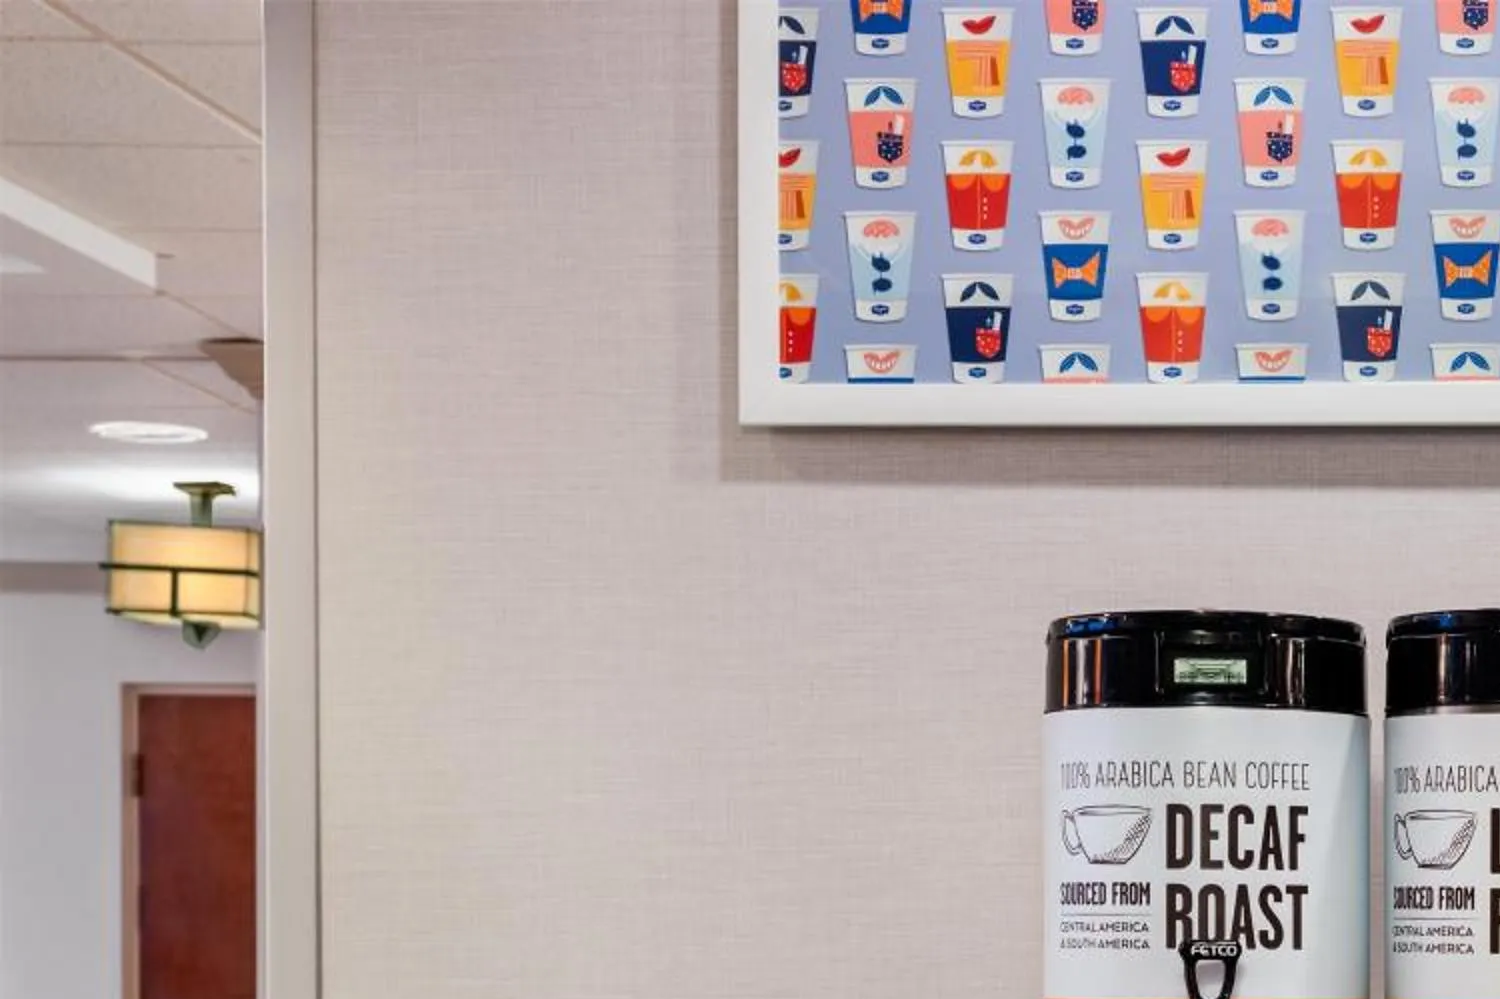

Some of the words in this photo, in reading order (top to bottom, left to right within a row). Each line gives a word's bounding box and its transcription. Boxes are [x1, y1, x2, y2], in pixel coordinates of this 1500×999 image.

[1095, 760, 1175, 790] ARABICA
[1183, 760, 1237, 789] BEAN
[1245, 762, 1310, 791] COFFEE
[1423, 764, 1499, 794] ARABICA
[1166, 803, 1309, 871] DECAF
[1060, 881, 1107, 906] SOURCED
[1112, 881, 1151, 906] FROM
[1439, 885, 1475, 911] FROM
[1098, 921, 1149, 933] AMERICA
[1165, 883, 1309, 951] ROAST
[1098, 938, 1150, 950] AMERICA
[1425, 926, 1474, 937] AMERICA
[1191, 944, 1238, 957] FETCO
[1425, 942, 1475, 955] AMERICA
